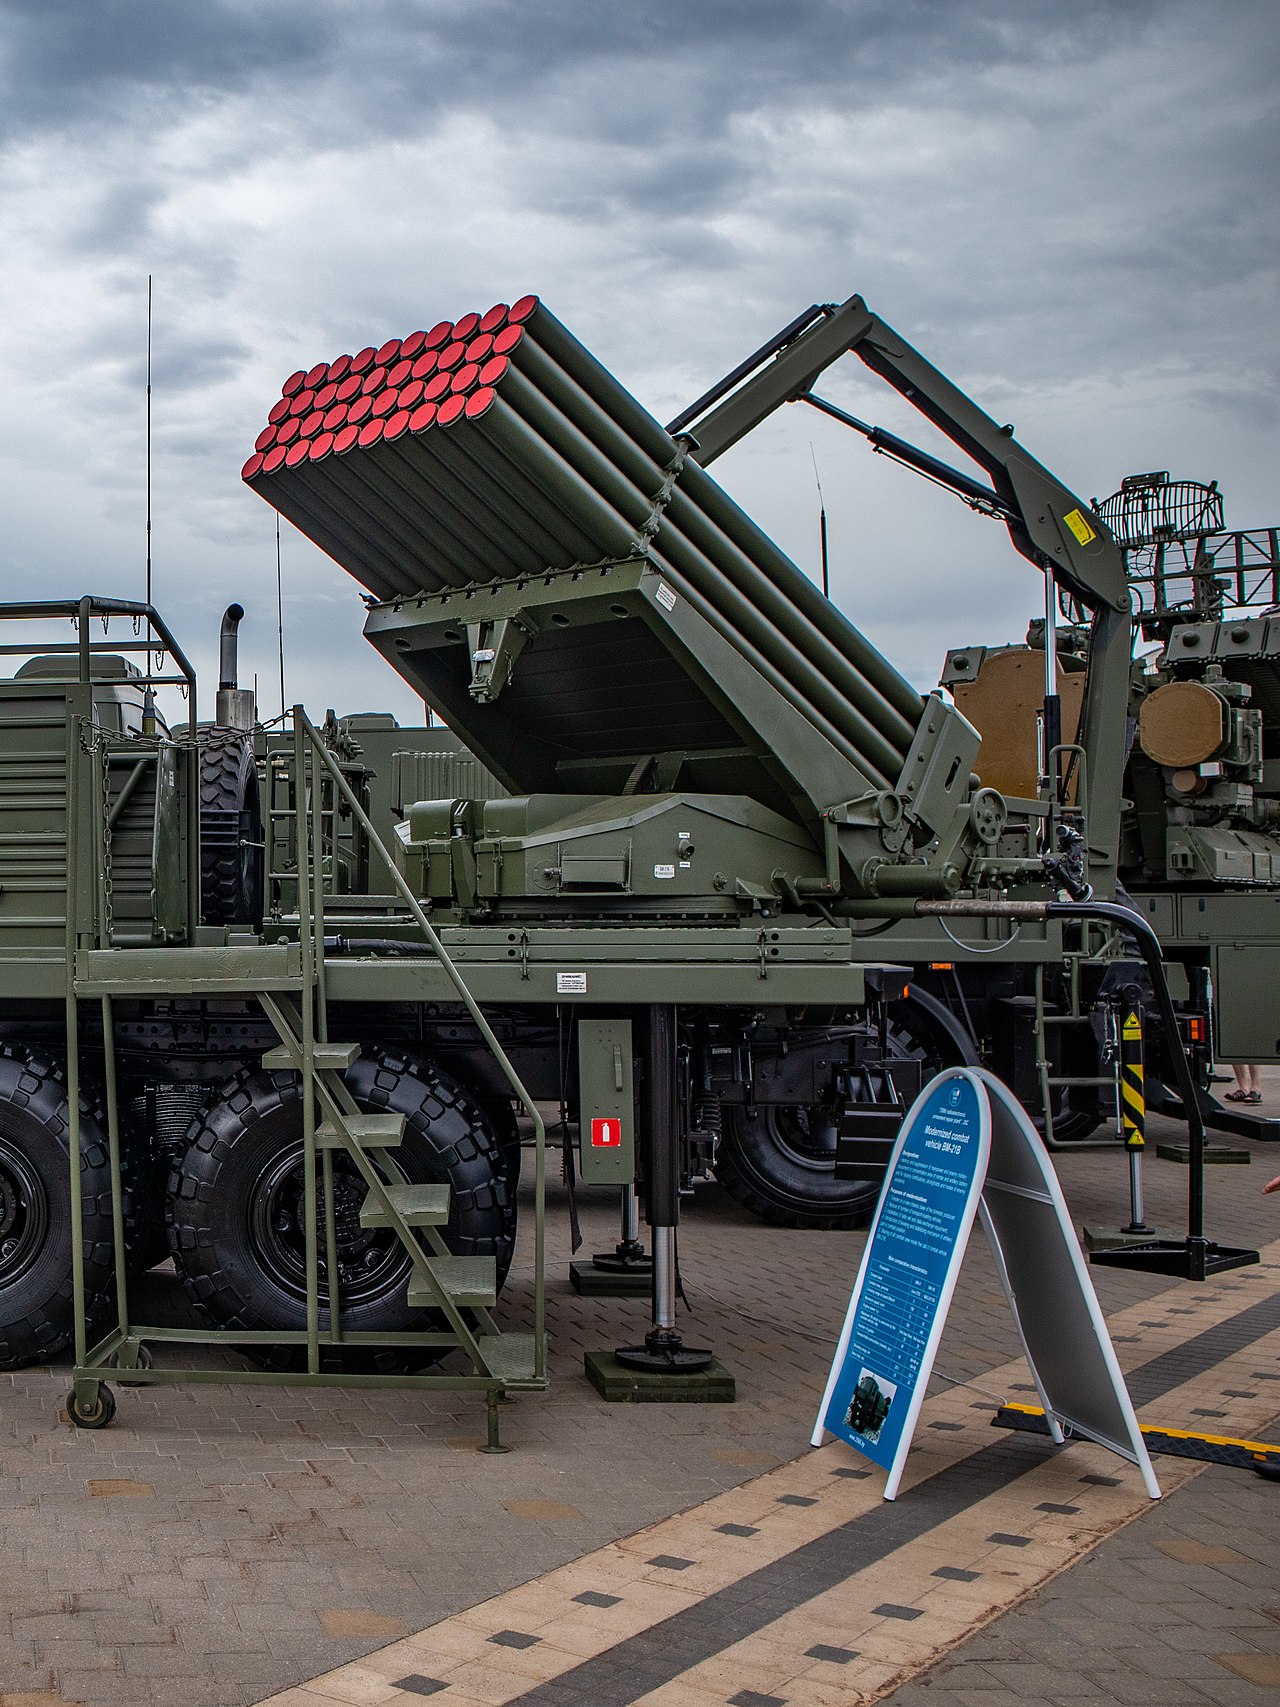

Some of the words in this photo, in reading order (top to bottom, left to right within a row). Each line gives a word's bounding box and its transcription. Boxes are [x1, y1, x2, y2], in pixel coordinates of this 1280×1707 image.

[924, 1125, 952, 1139] Modernized
[951, 1133, 970, 1144] combat
[925, 1139, 942, 1151] vehicle
